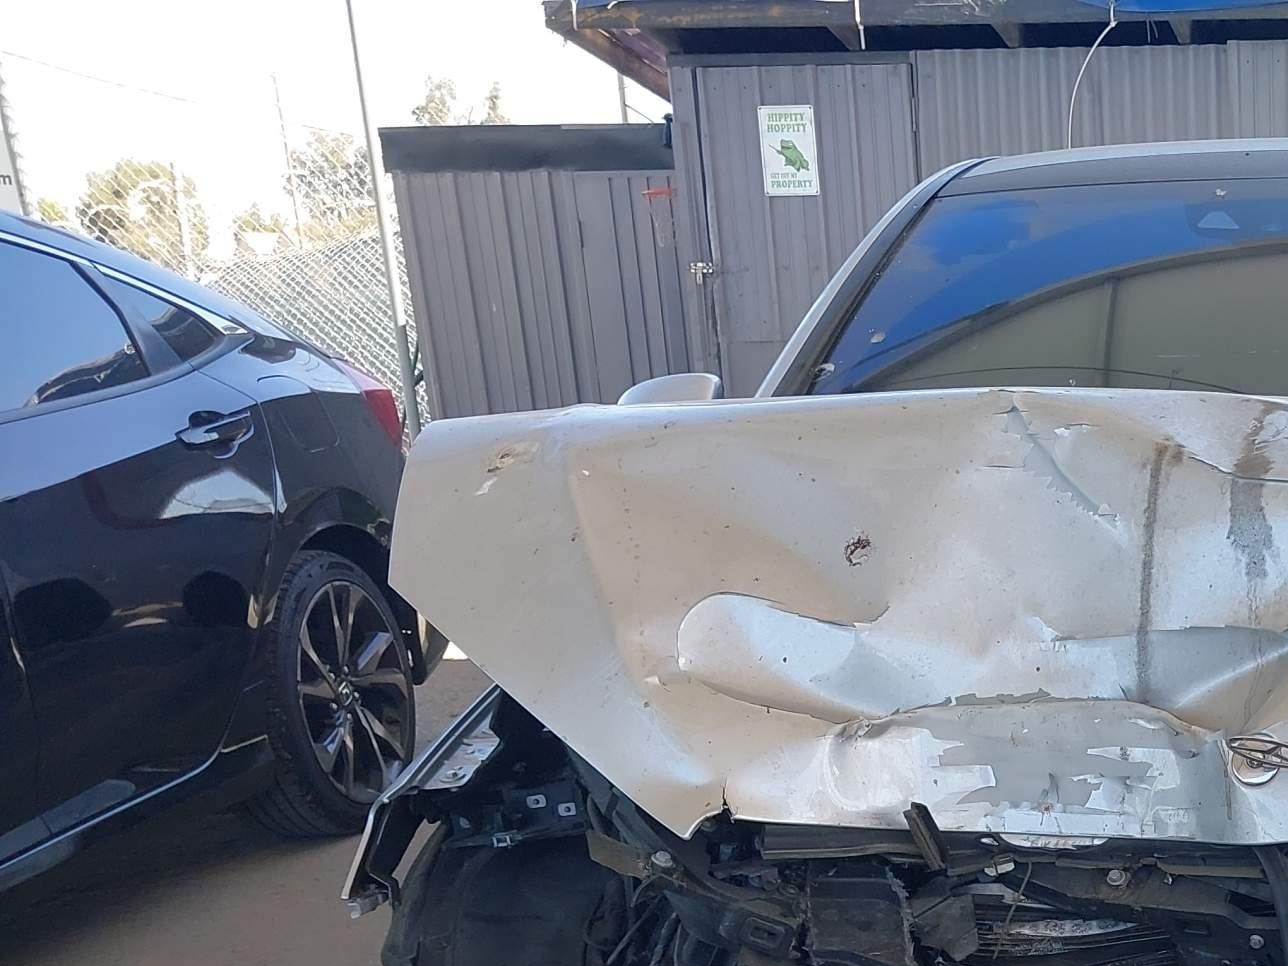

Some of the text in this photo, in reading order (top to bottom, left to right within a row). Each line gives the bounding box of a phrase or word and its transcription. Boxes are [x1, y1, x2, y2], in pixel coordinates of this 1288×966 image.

[767, 112, 805, 122] HIPPITY
[767, 123, 807, 133] HOPPITY
[771, 180, 813, 189] PROPERTY
